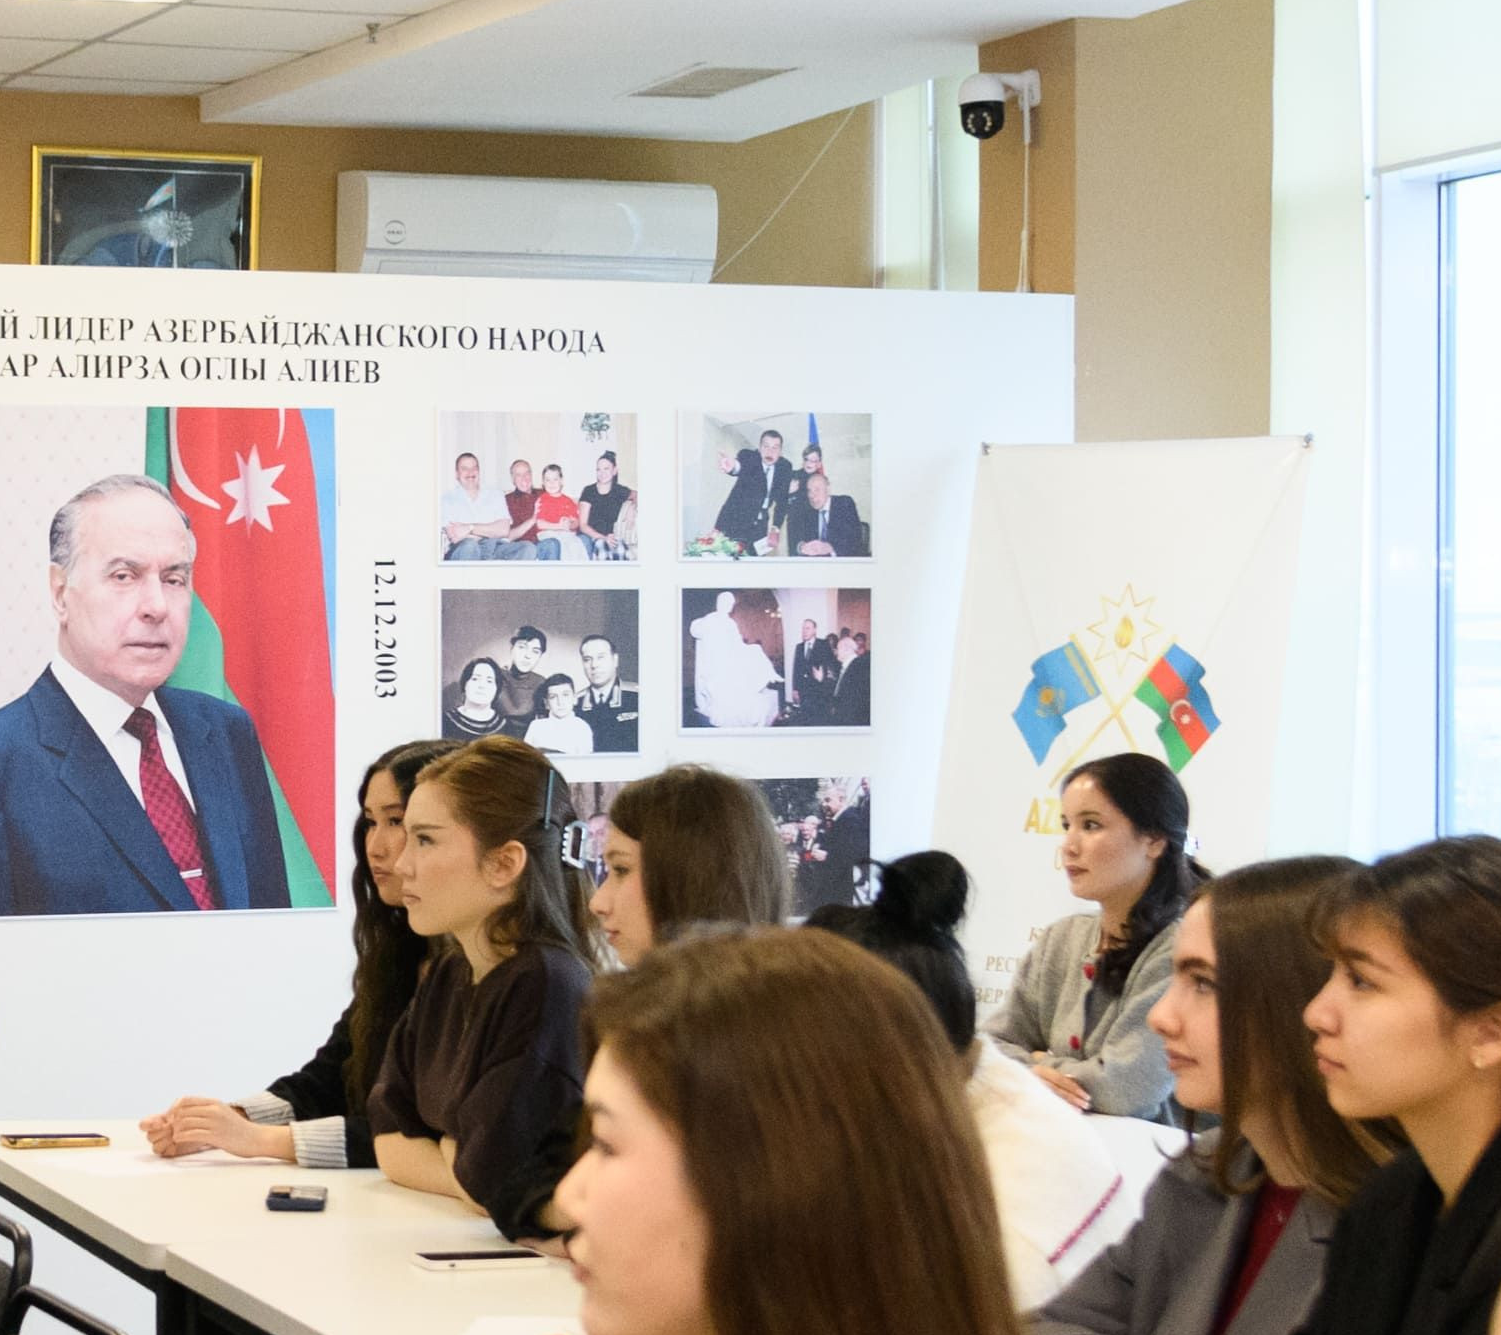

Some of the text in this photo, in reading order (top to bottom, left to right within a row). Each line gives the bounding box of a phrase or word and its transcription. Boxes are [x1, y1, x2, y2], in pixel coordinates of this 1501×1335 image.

[29, 316, 135, 343] ЛИДЕР
[144, 315, 478, 350] АЗЕРБАЙДЖАНСКОГО
[487, 326, 606, 355] НАРОДА
[47, 354, 170, 381] АЛИРЗА
[180, 356, 266, 382] ОГЛЫ
[277, 359, 380, 384] АЛИЕВ
[374, 560, 397, 698] 12.12.2003
